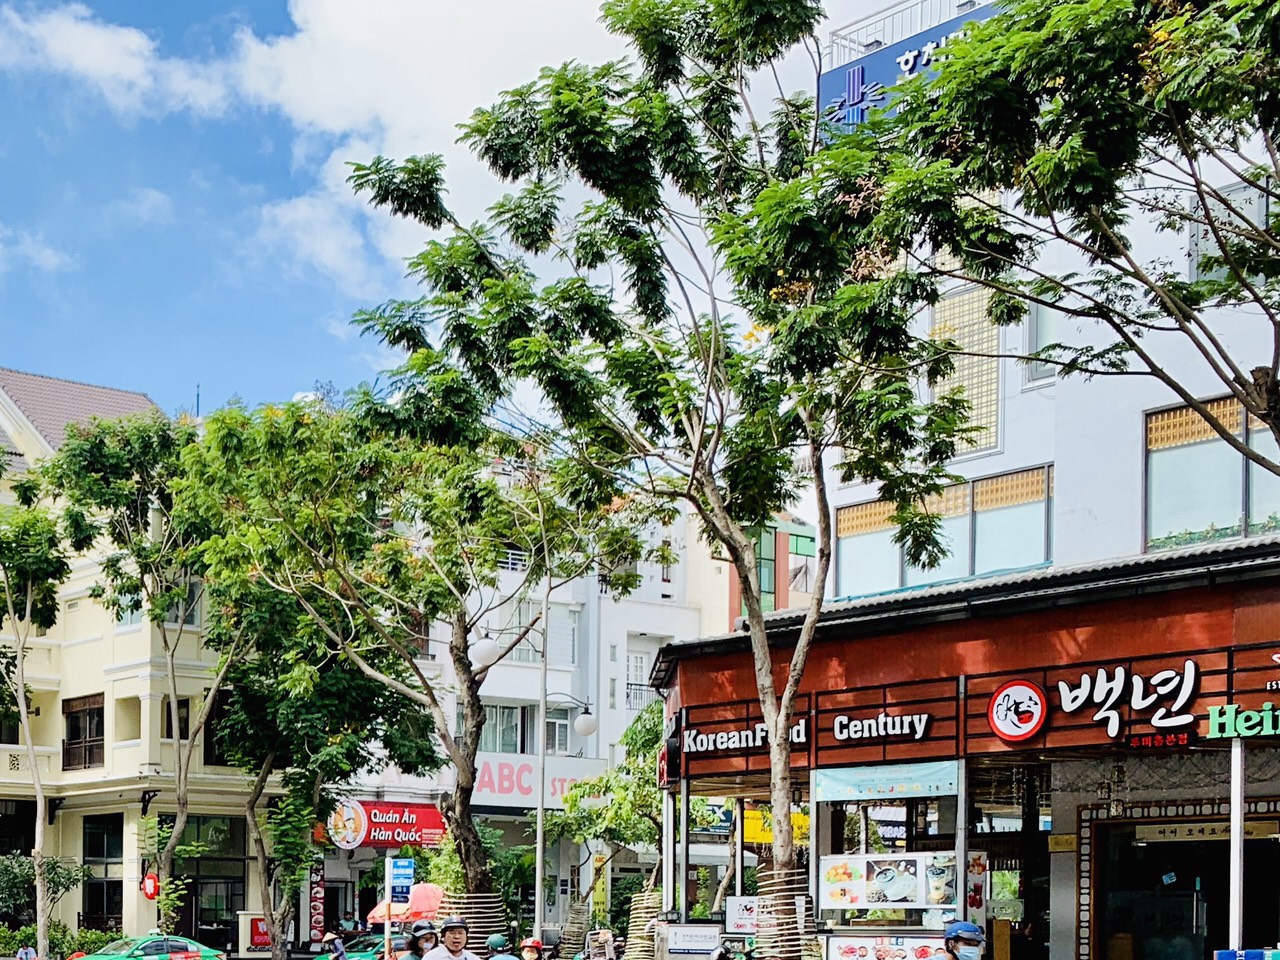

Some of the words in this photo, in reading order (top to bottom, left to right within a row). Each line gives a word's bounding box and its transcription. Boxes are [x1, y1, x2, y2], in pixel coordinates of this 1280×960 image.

[1058, 659, 1196, 738] 백년
[683, 719, 806, 753] KoreanFd
[834, 713, 929, 741] Century
[1206, 702, 1280, 739] Hei
[476, 761, 533, 796] ABC
[370, 809, 400, 823] Quán
[402, 809, 417, 824] Ăn
[370, 828, 393, 841] Hàn
[394, 826, 422, 842] Quốc
